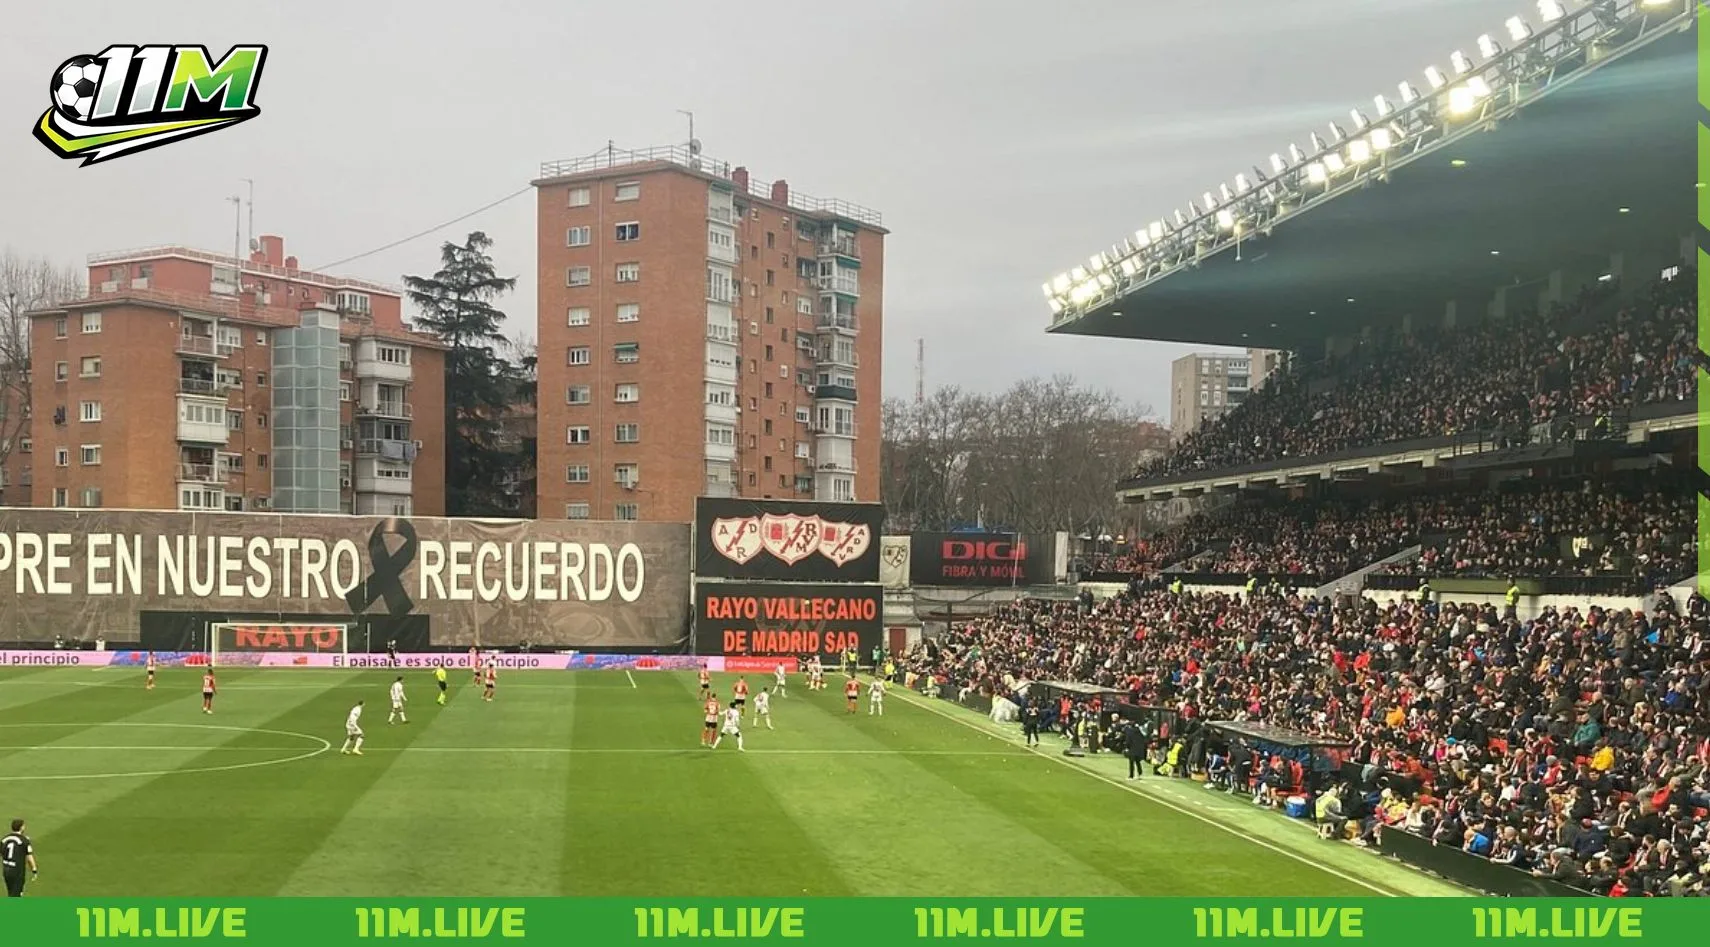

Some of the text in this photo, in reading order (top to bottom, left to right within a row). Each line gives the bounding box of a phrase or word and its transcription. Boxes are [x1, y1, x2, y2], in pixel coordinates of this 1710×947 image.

[87, 533, 142, 595] EN
[158, 535, 361, 600] NUESTRO
[420, 540, 645, 602] RECUERDO
[942, 565, 976, 577] FIBRA
[980, 565, 988, 577] Y
[706, 597, 876, 620] RAYO VALLECANO
[235, 625, 339, 649] RAYO
[723, 630, 859, 653] DE MADRID SAD
[12, 652, 80, 665] principio
[349, 655, 402, 667] paisae
[405, 657, 419, 667] es
[424, 655, 454, 667] solo
[458, 656, 471, 667] el
[475, 656, 540, 669] prncipio
[6, 842, 15, 859] 1
